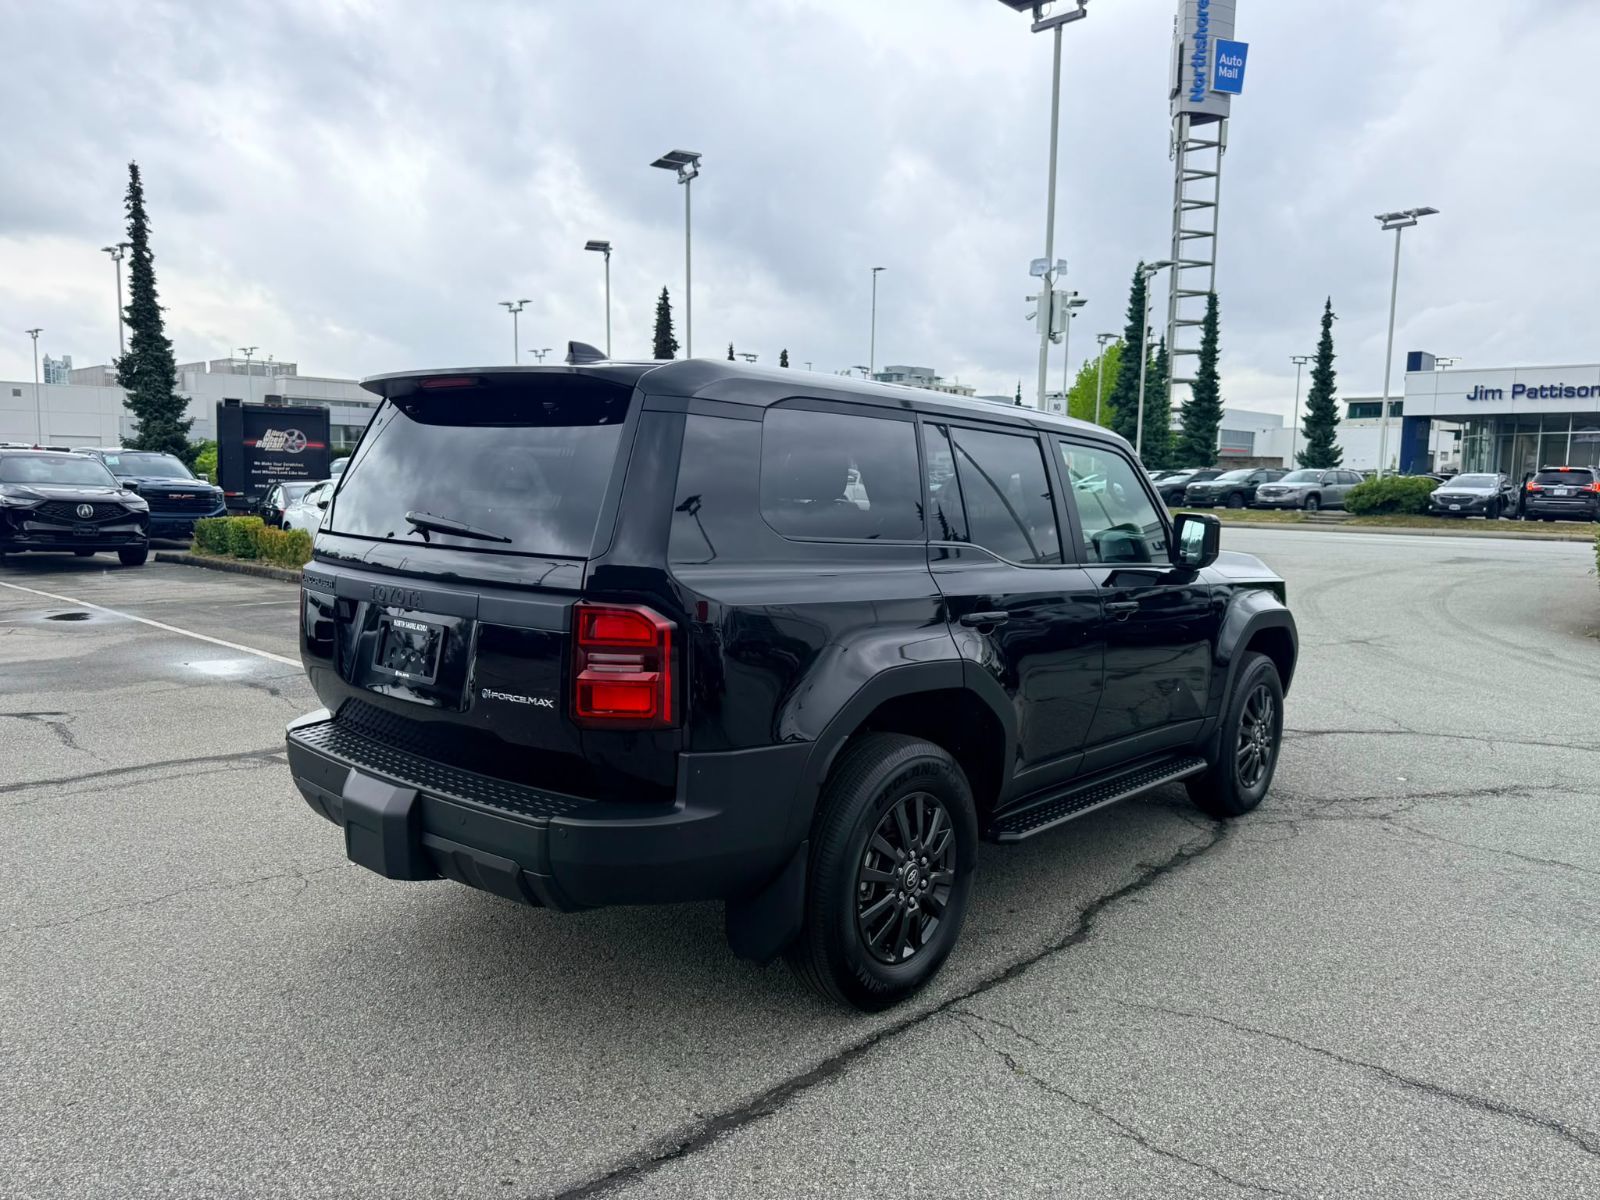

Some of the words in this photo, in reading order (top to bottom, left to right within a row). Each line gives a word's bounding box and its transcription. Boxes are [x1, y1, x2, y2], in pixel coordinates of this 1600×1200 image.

[1188, 0, 1209, 102] Northshore
[1219, 54, 1242, 67] Auto
[1218, 67, 1238, 79] Mall
[1466, 385, 1503, 401] Jim
[369, 584, 424, 608] TOYOTA
